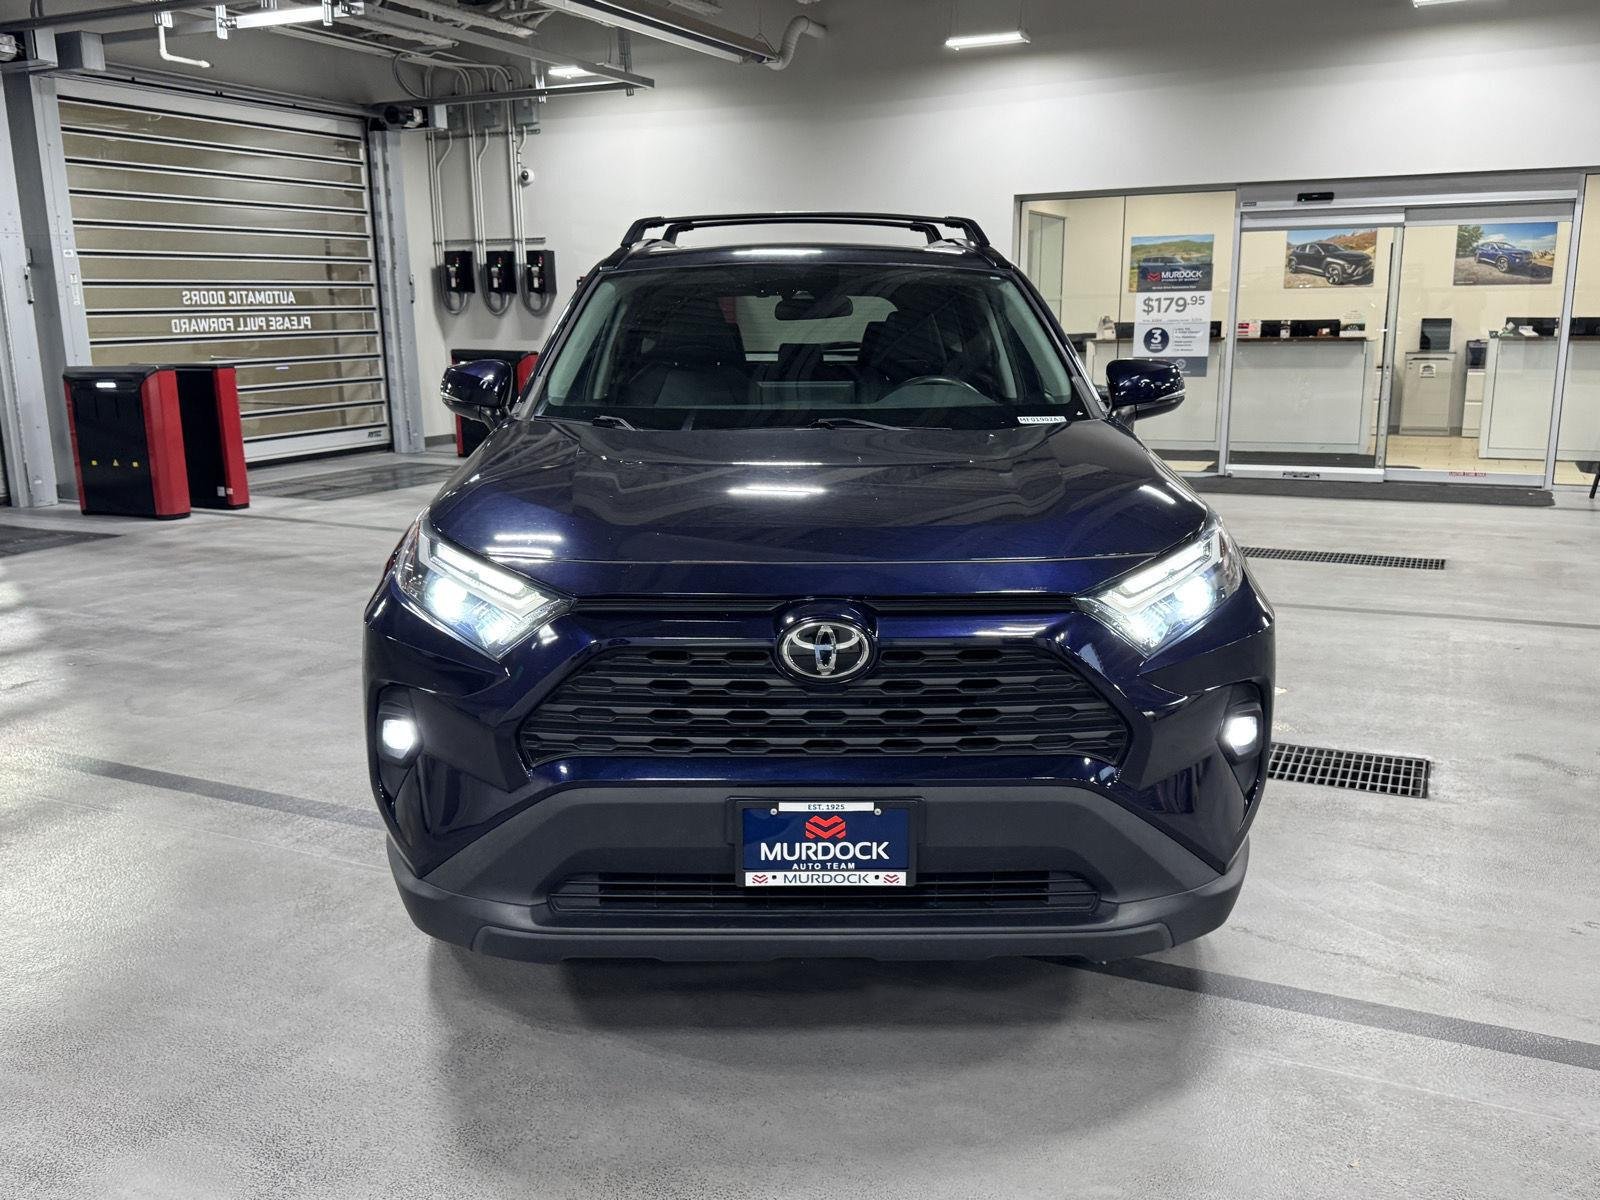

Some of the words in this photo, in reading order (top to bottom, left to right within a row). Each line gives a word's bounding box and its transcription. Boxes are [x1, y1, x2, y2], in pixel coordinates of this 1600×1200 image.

[1151, 330, 1162, 343] 3
[761, 842, 890, 860] MURDOCK
[792, 862, 821, 870] AUTO
[826, 862, 855, 870] TEAM
[783, 873, 869, 884] MURDOCK
